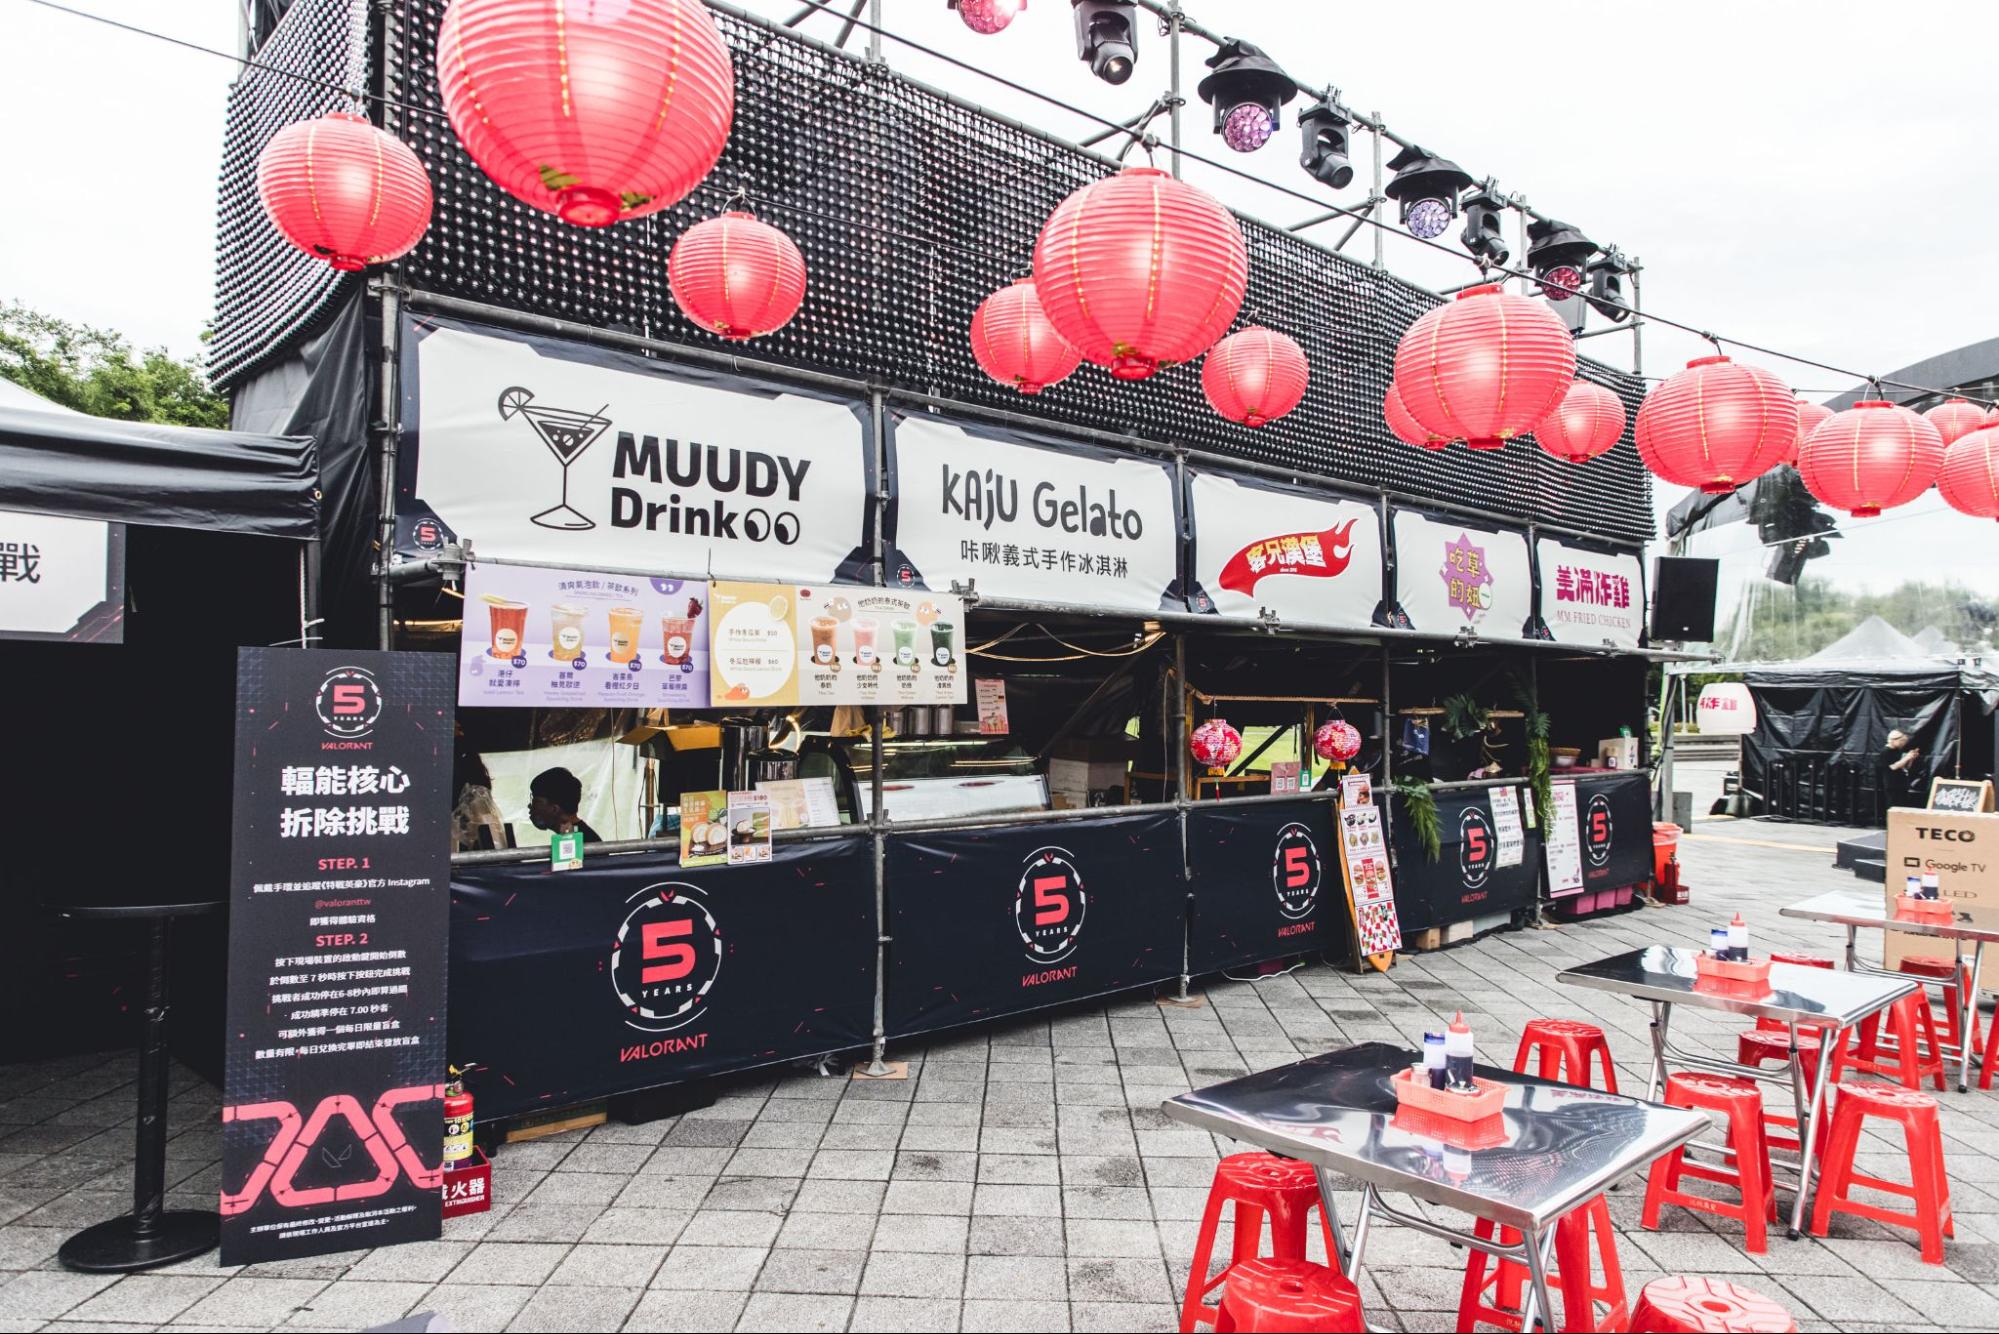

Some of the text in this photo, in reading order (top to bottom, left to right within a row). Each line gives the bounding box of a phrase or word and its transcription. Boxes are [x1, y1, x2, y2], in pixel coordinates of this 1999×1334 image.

[612, 431, 811, 501] MUUDY
[1033, 481, 1143, 540] Gelato
[0, 542, 41, 584] 戰
[960, 539, 1129, 579] 咔啾義式手作冰淇淋
[1449, 546, 1480, 578] 吃草
[1556, 564, 1630, 609] 美滿炸雞
[1573, 611, 1596, 625] FRIED
[1598, 614, 1631, 629] CHICKEN
[333, 684, 366, 714] 5
[320, 742, 374, 750] VALORANT
[280, 765, 411, 796] 輻能核心
[280, 805, 411, 838] 拆除挑戰
[1592, 812, 1607, 842] 5
[1915, 827, 1976, 843] TECO
[1467, 827, 1487, 862] 5
[318, 857, 371, 871] STEP. 1
[1285, 846, 1310, 888] 5
[1925, 859, 1987, 873] Google TV
[387, 878, 430, 887] Instagram
[1033, 875, 1070, 926] 5
[315, 933, 369, 947] STEP. 2
[1035, 926, 1069, 937] YEARS
[1277, 921, 1316, 938] VALORANT
[642, 918, 697, 984] 5
[310, 974, 317, 982] 7
[641, 983, 693, 999] YEARS
[1022, 966, 1078, 987] VALORANT
[350, 1006, 369, 1014] 7.00
[619, 1033, 709, 1063] VALORANT
